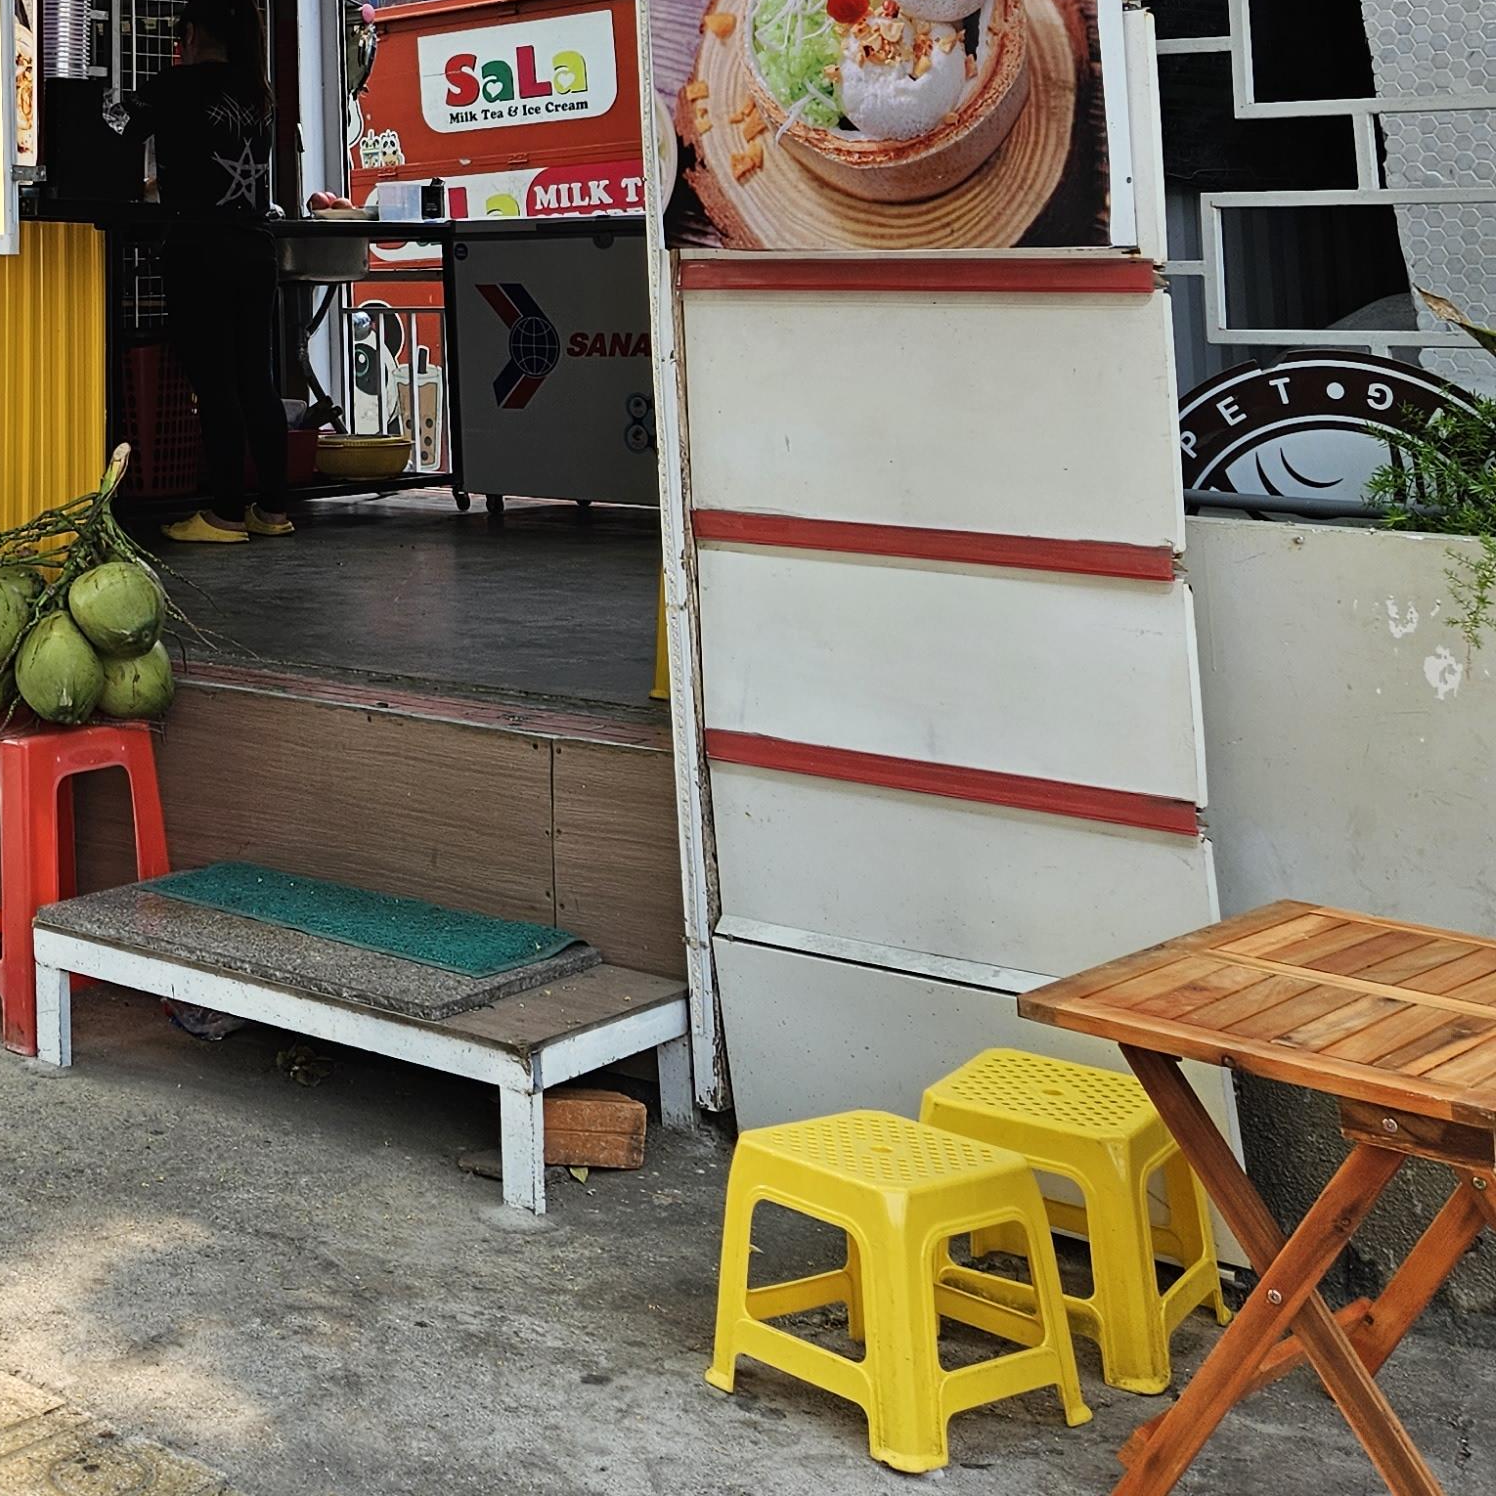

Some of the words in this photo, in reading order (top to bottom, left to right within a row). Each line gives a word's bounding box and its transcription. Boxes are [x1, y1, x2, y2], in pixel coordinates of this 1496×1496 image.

[445, 44, 589, 107] SaLa
[449, 110, 478, 125] Milk
[480, 106, 504, 121] Tea
[507, 104, 520, 118] &
[522, 102, 542, 116] Ice
[545, 99, 589, 113] Cream
[533, 178, 614, 211] MILK
